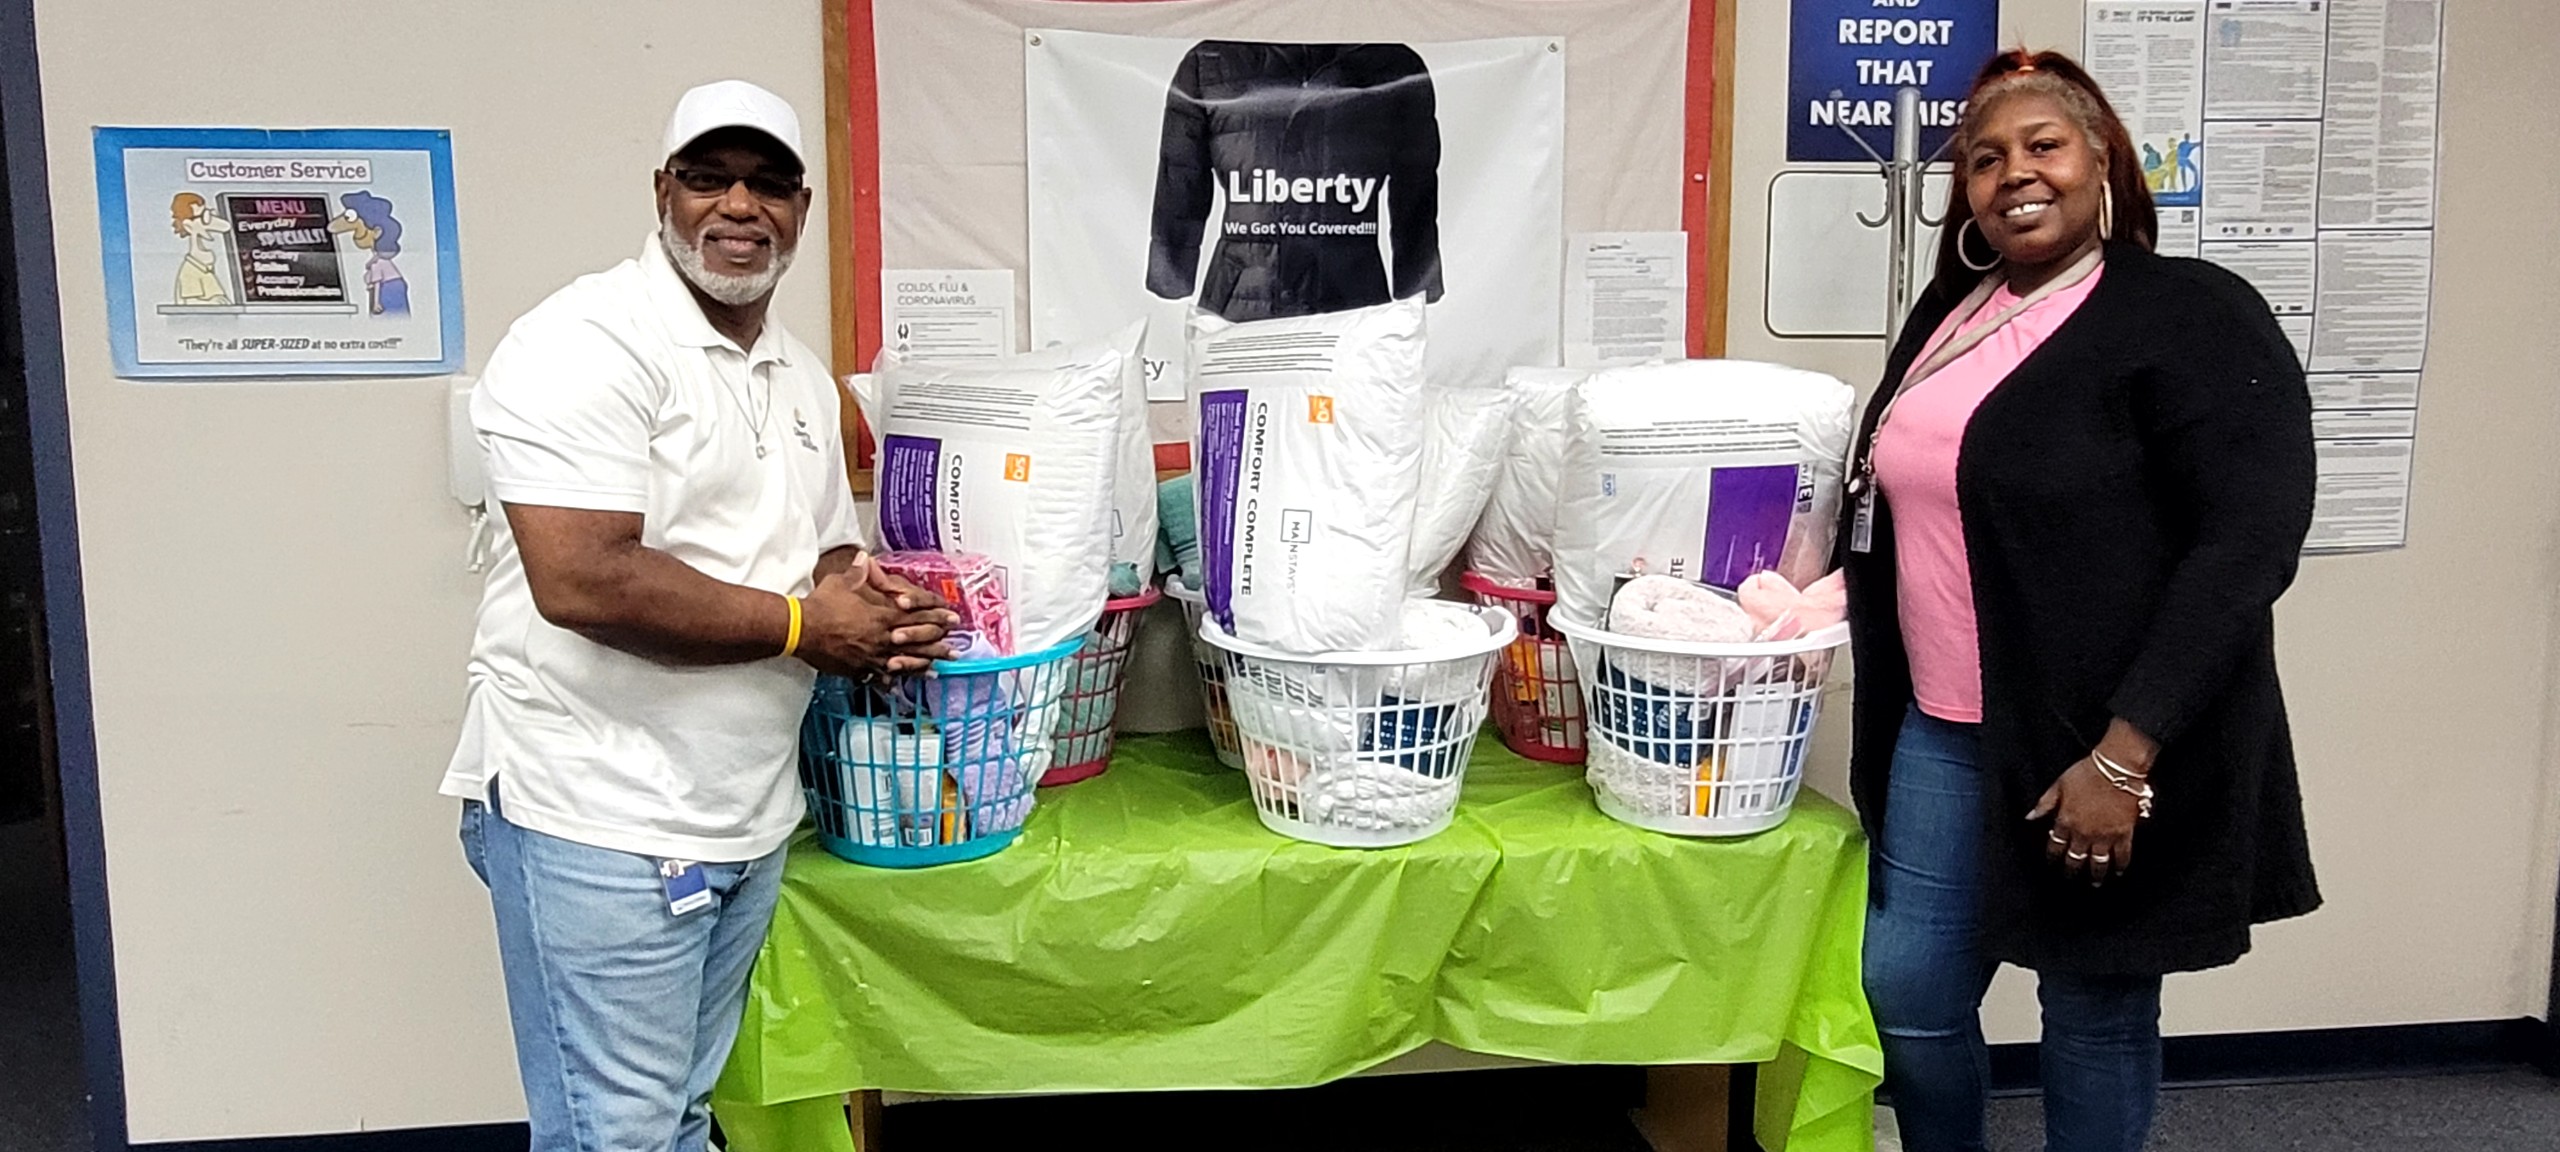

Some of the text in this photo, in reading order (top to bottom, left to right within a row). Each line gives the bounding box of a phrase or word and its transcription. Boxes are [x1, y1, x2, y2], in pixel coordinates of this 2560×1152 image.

[1839, 19, 1954, 45] REPORT
[1856, 59, 1933, 86] THAT
[1810, 100, 1893, 126] NEAR
[191, 161, 367, 179] Customer Service
[1229, 168, 1376, 213] Liberty
[256, 200, 306, 213] MENU
[239, 217, 297, 231] Everyday
[1225, 222, 1377, 235] We Got You Covered!!!
[257, 228, 328, 246] SPECIALS!
[897, 283, 969, 293] COLDS, FLU &
[897, 295, 977, 306] CORONAVIRUS
[226, 339, 238, 350] all
[240, 338, 310, 350] SUPER-SIZED
[311, 340, 322, 350] at
[324, 341, 338, 350] no
[340, 340, 365, 350] extra
[1250, 402, 1267, 493] COMFORT
[949, 454, 963, 544] COMFORT
[1241, 498, 1258, 596] COMPLETE
